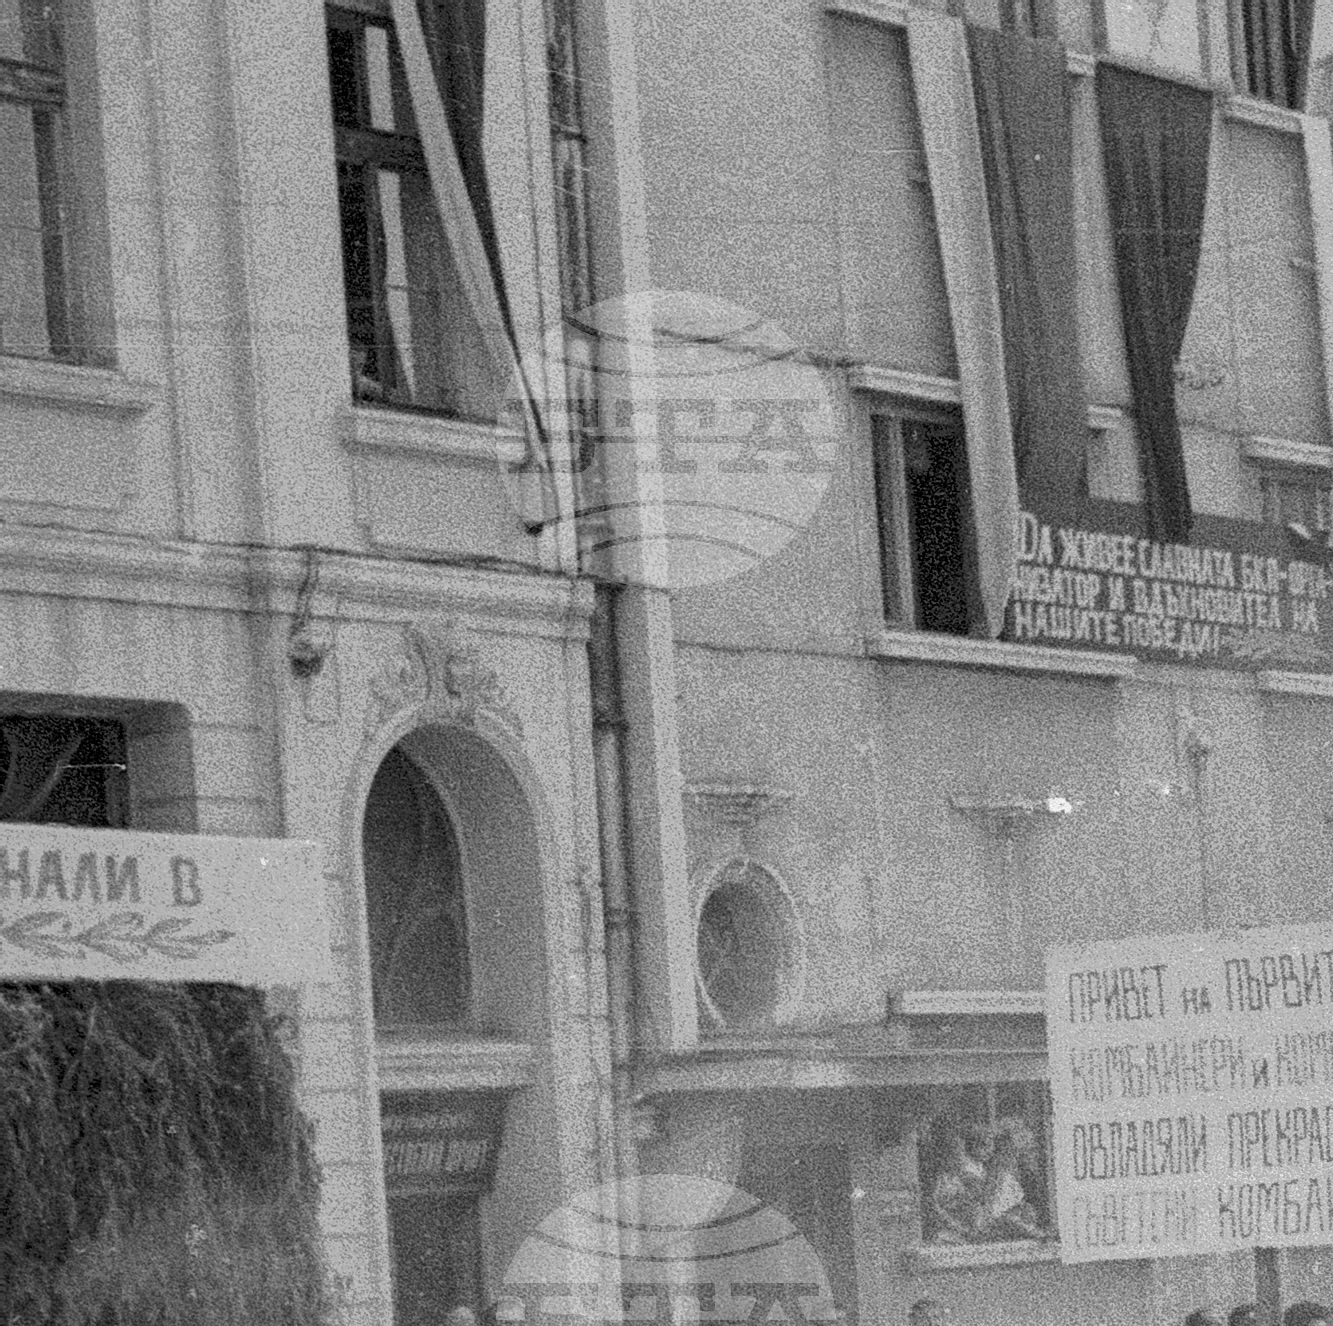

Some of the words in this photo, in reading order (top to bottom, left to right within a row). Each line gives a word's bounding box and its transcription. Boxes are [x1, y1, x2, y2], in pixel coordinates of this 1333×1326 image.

[1017, 512, 1054, 565] ДА
[1058, 528, 1137, 575] ЖИВЕЕ
[1108, 579, 1126, 611] И
[1013, 604, 1121, 645] НАШИТЕ
[170, 855, 203, 907] В
[1068, 963, 1167, 1023] ПРИВЕТ
[1072, 1113, 1207, 1181] ОВЛАДЯЛИ
